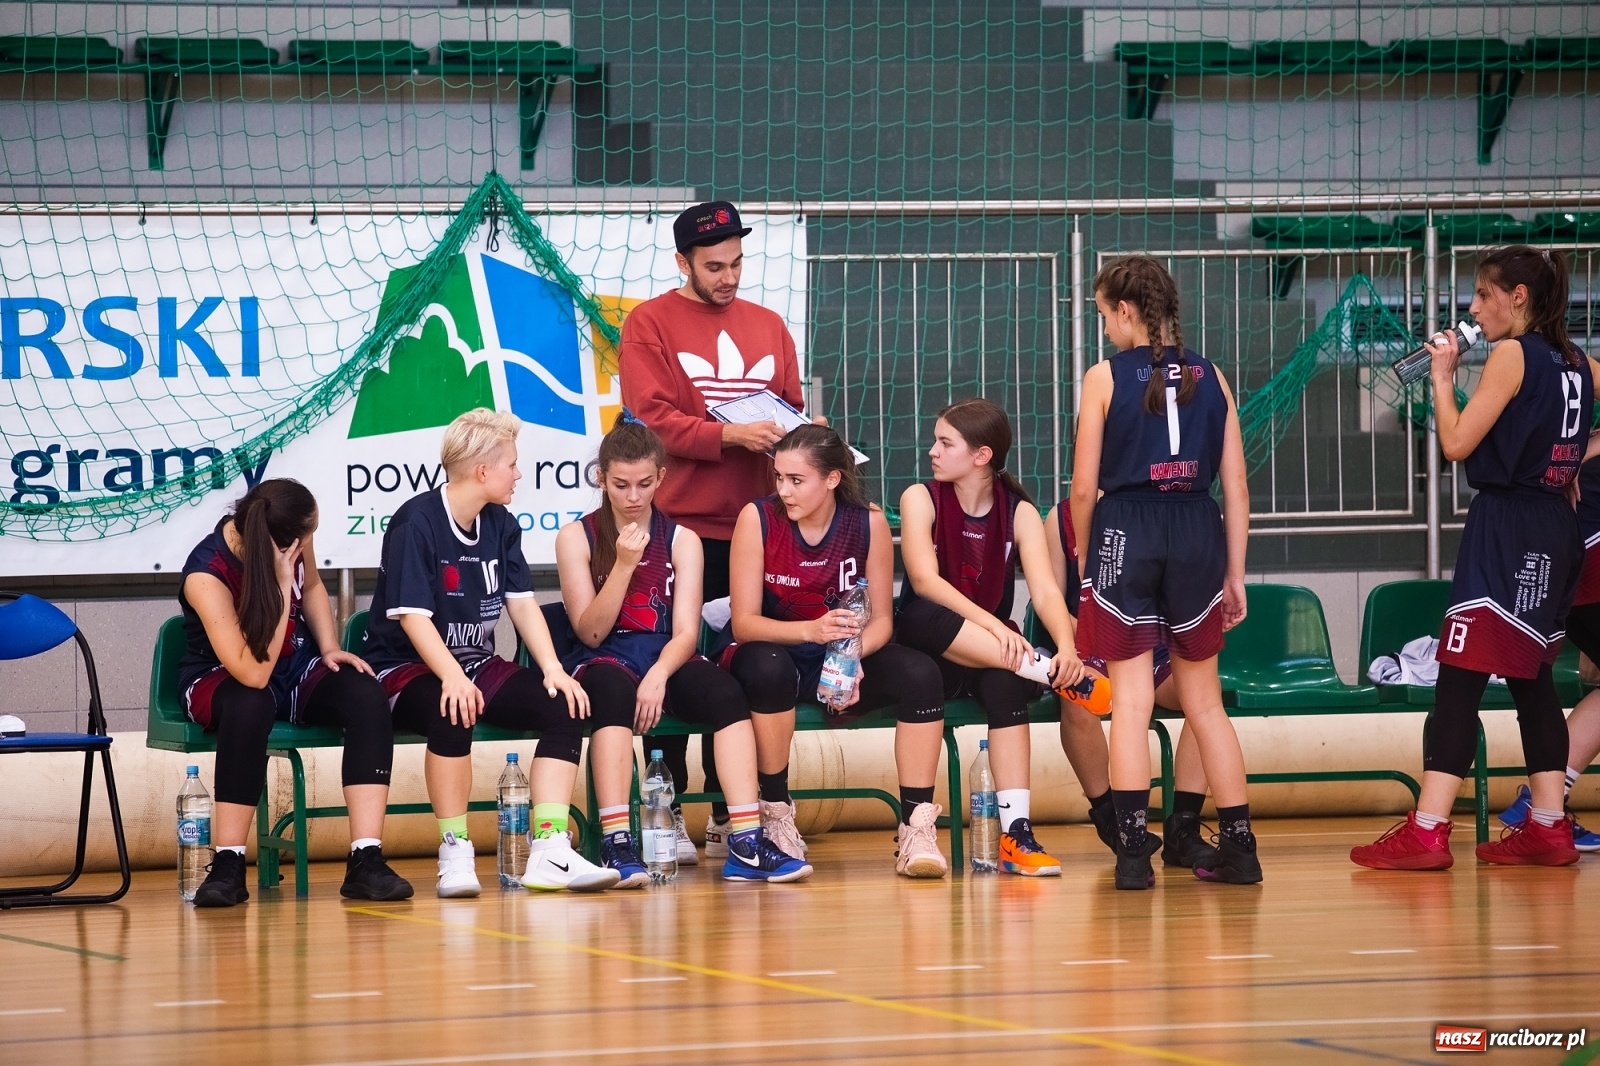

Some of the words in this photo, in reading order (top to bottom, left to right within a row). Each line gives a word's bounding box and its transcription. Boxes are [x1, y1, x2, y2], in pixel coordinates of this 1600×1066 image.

[0, 296, 261, 380] RSKI
[10, 443, 274, 513] gramy
[347, 461, 449, 506] pow
[535, 460, 602, 490] rac
[347, 508, 391, 535] zie
[776, 573, 800, 587] DWÓJKA
[838, 557, 858, 592] 12
[1446, 621, 1468, 653] 13
[916, 706, 944, 714] TARMA
